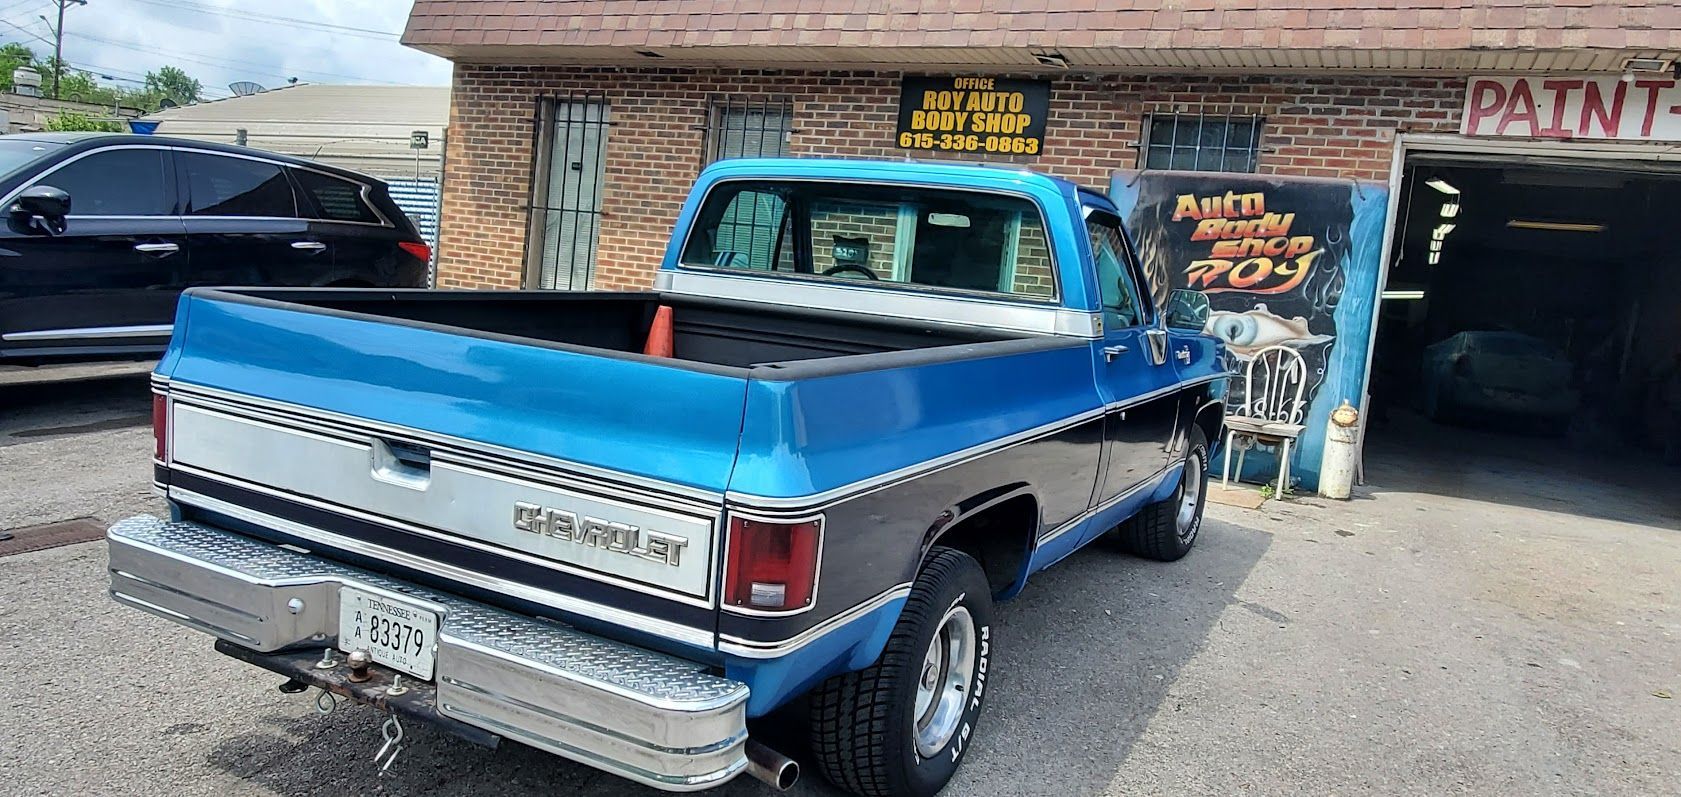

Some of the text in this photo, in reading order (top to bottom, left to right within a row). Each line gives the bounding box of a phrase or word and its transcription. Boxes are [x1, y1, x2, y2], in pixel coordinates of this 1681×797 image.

[954, 77, 995, 90] OFFICE
[922, 90, 1024, 113] ROY AUTO
[911, 110, 1031, 134] BODY SHOP
[900, 132, 1039, 154] 615-336-0863
[1172, 190, 1265, 222] Auto
[512, 500, 689, 567] CHEVROLET
[355, 610, 363, 623] A
[367, 598, 411, 621] TENNESSEE
[354, 625, 362, 639] A
[370, 615, 424, 657] 83379
[951, 625, 990, 763] RADIAL G/T
